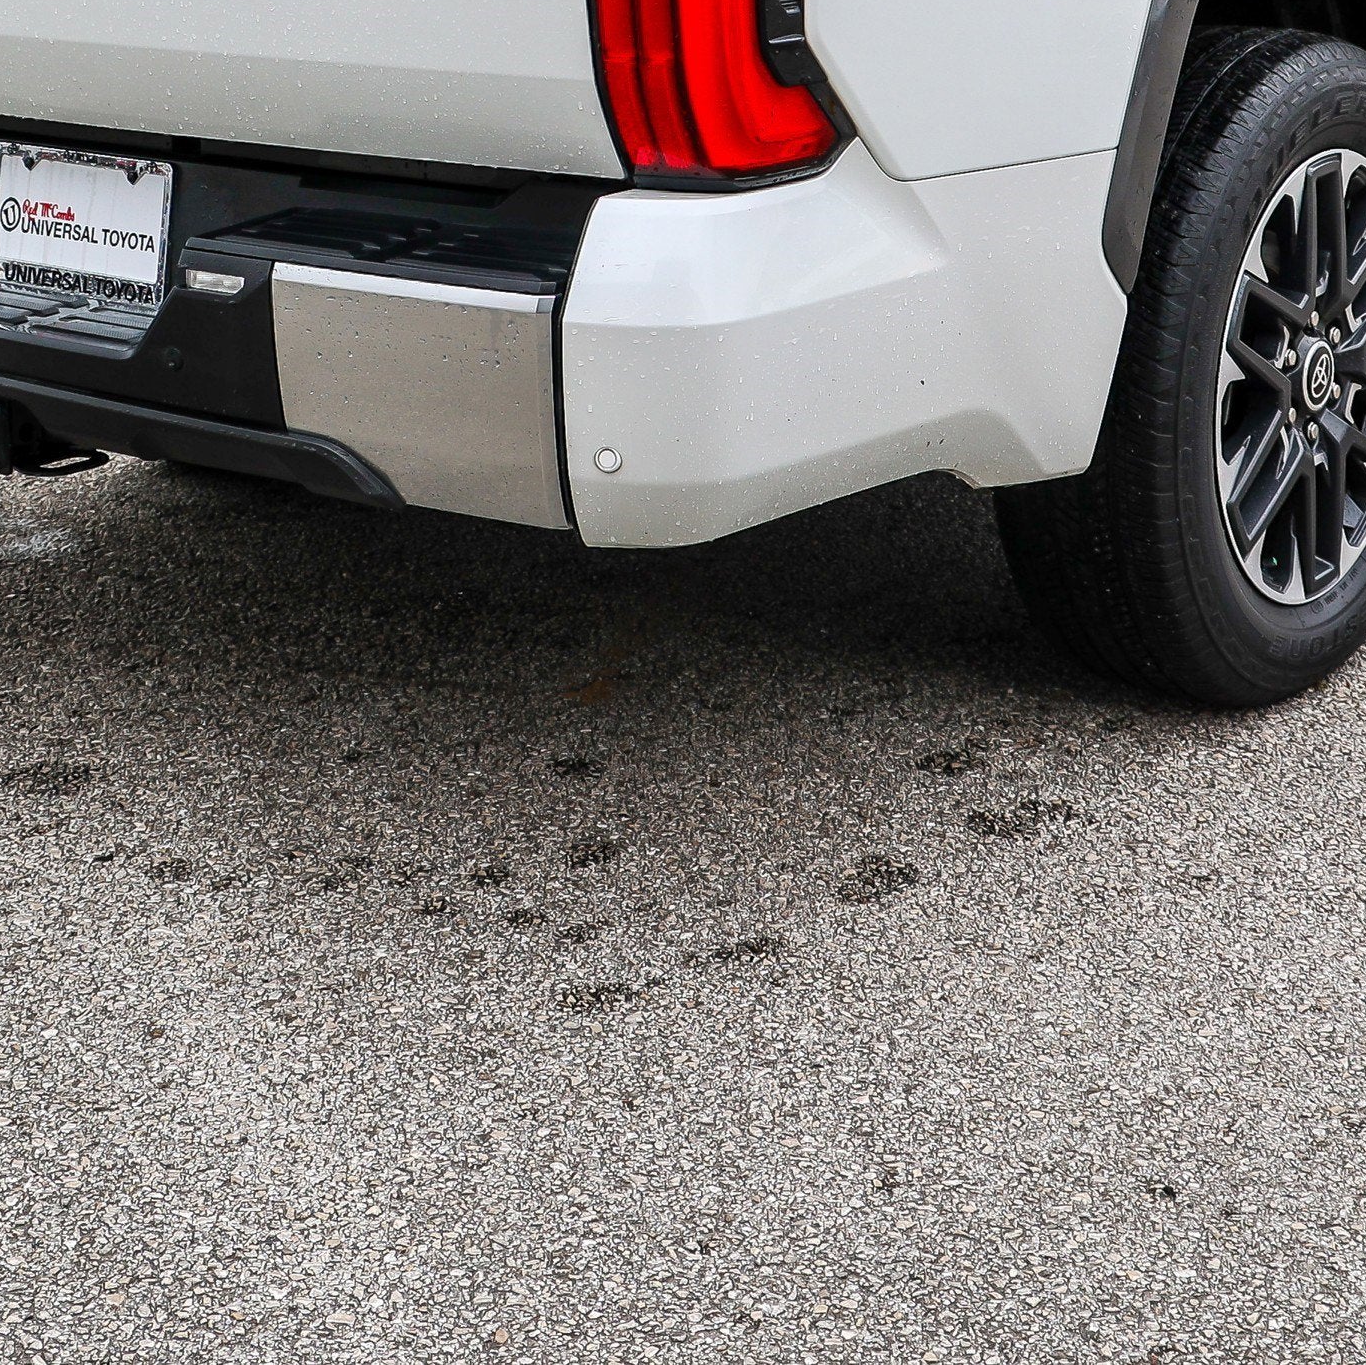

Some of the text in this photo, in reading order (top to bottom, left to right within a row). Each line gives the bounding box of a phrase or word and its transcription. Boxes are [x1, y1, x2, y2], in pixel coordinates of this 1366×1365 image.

[21, 216, 156, 253] UNIVERSAL TOYOTA
[4, 262, 94, 296] UNIVERSAL
[93, 276, 156, 304] TOYOTA
